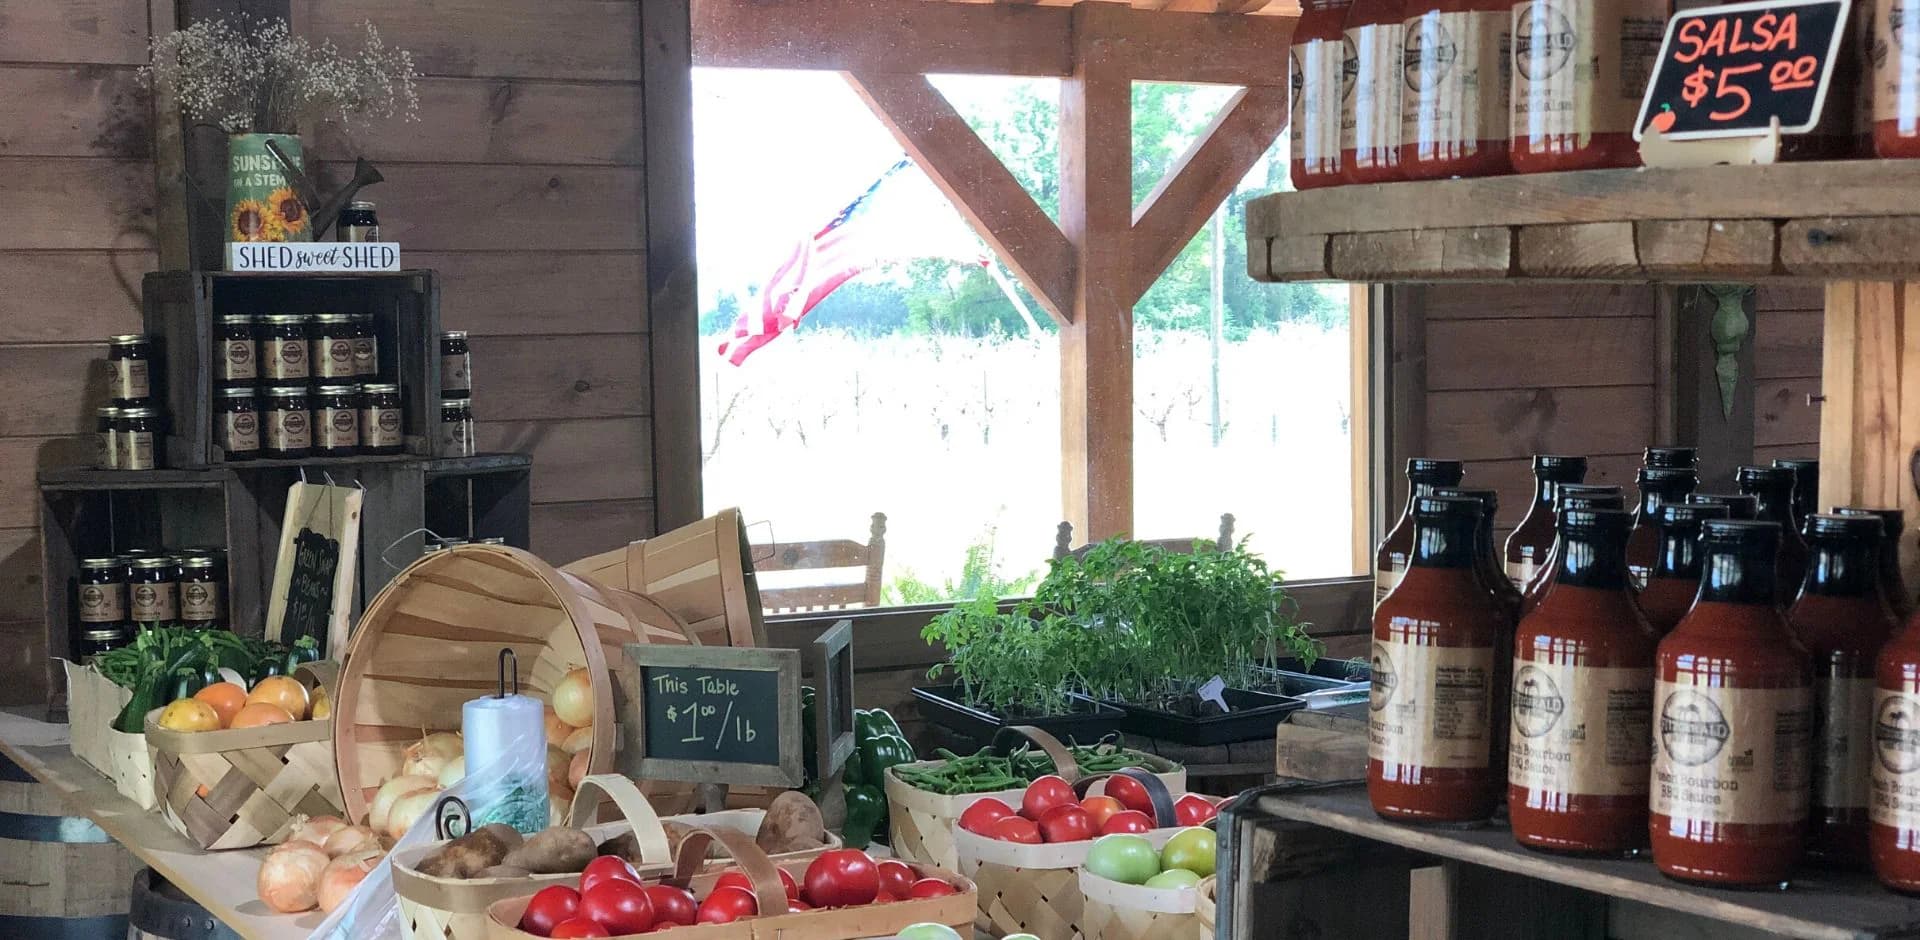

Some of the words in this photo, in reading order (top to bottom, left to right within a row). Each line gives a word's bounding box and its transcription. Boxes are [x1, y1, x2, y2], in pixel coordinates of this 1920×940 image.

[1674, 12, 1798, 63] SALSA
[245, 178, 252, 187] A
[254, 174, 286, 187] STEM
[239, 246, 293, 268] SHED
[295, 247, 340, 269] sweet
[342, 246, 394, 268] SHED
[652, 673, 689, 695] This
[696, 675, 740, 696] Table
[1372, 720, 1404, 735] ourbon
[1523, 743, 1571, 761] Bourbon
[1680, 773, 1739, 791] Bourbon
[1681, 788, 1721, 805] Sauce
